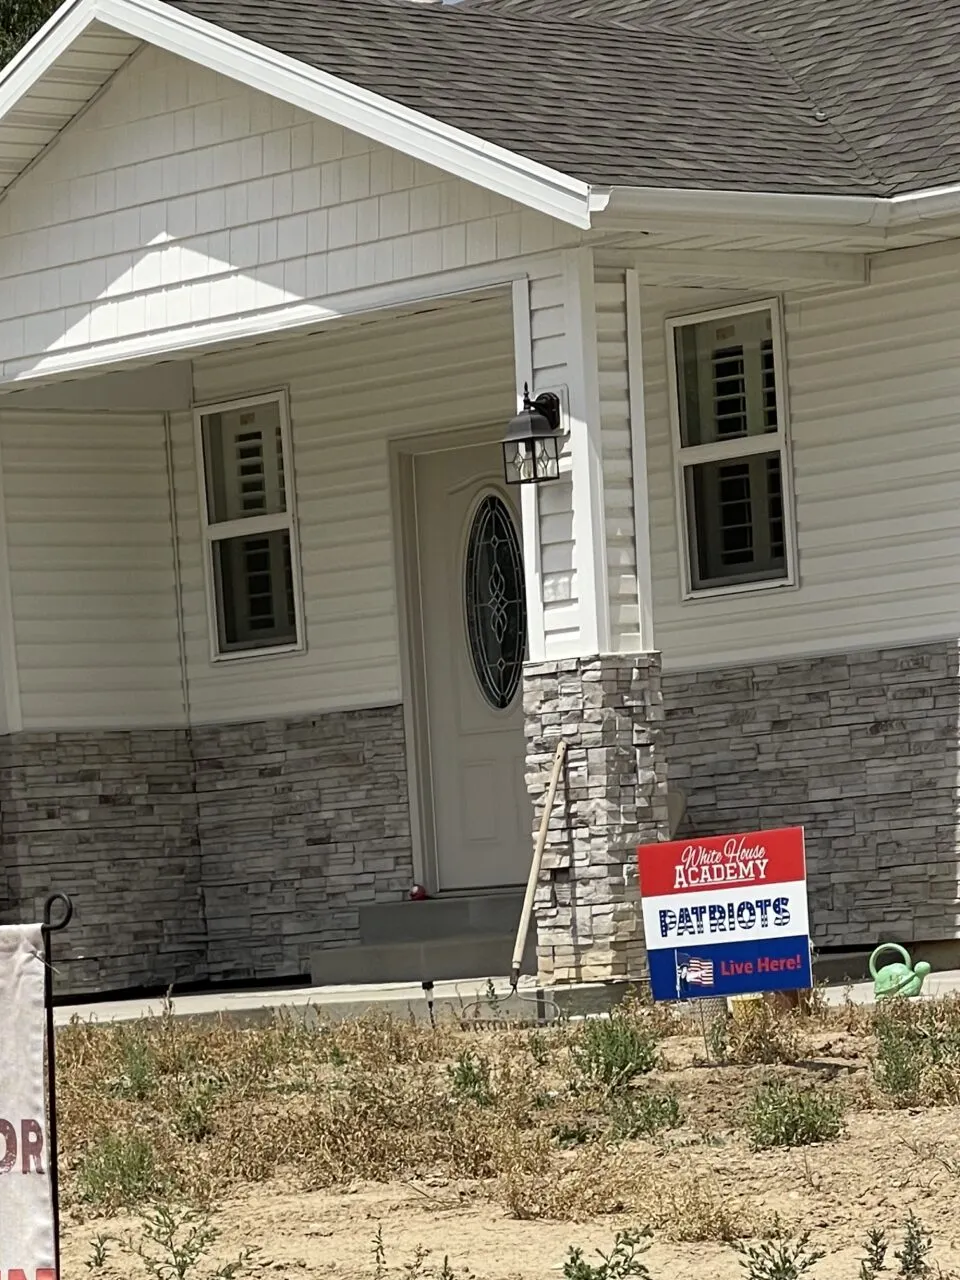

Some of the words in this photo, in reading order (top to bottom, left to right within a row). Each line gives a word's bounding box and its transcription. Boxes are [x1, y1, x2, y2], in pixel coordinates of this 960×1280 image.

[681, 846, 722, 868] White
[724, 837, 765, 865] House
[674, 859, 768, 888] ACADEMY
[659, 897, 790, 937] PATRIOTS
[720, 959, 753, 976] Live
[757, 954, 802, 973] Here!
